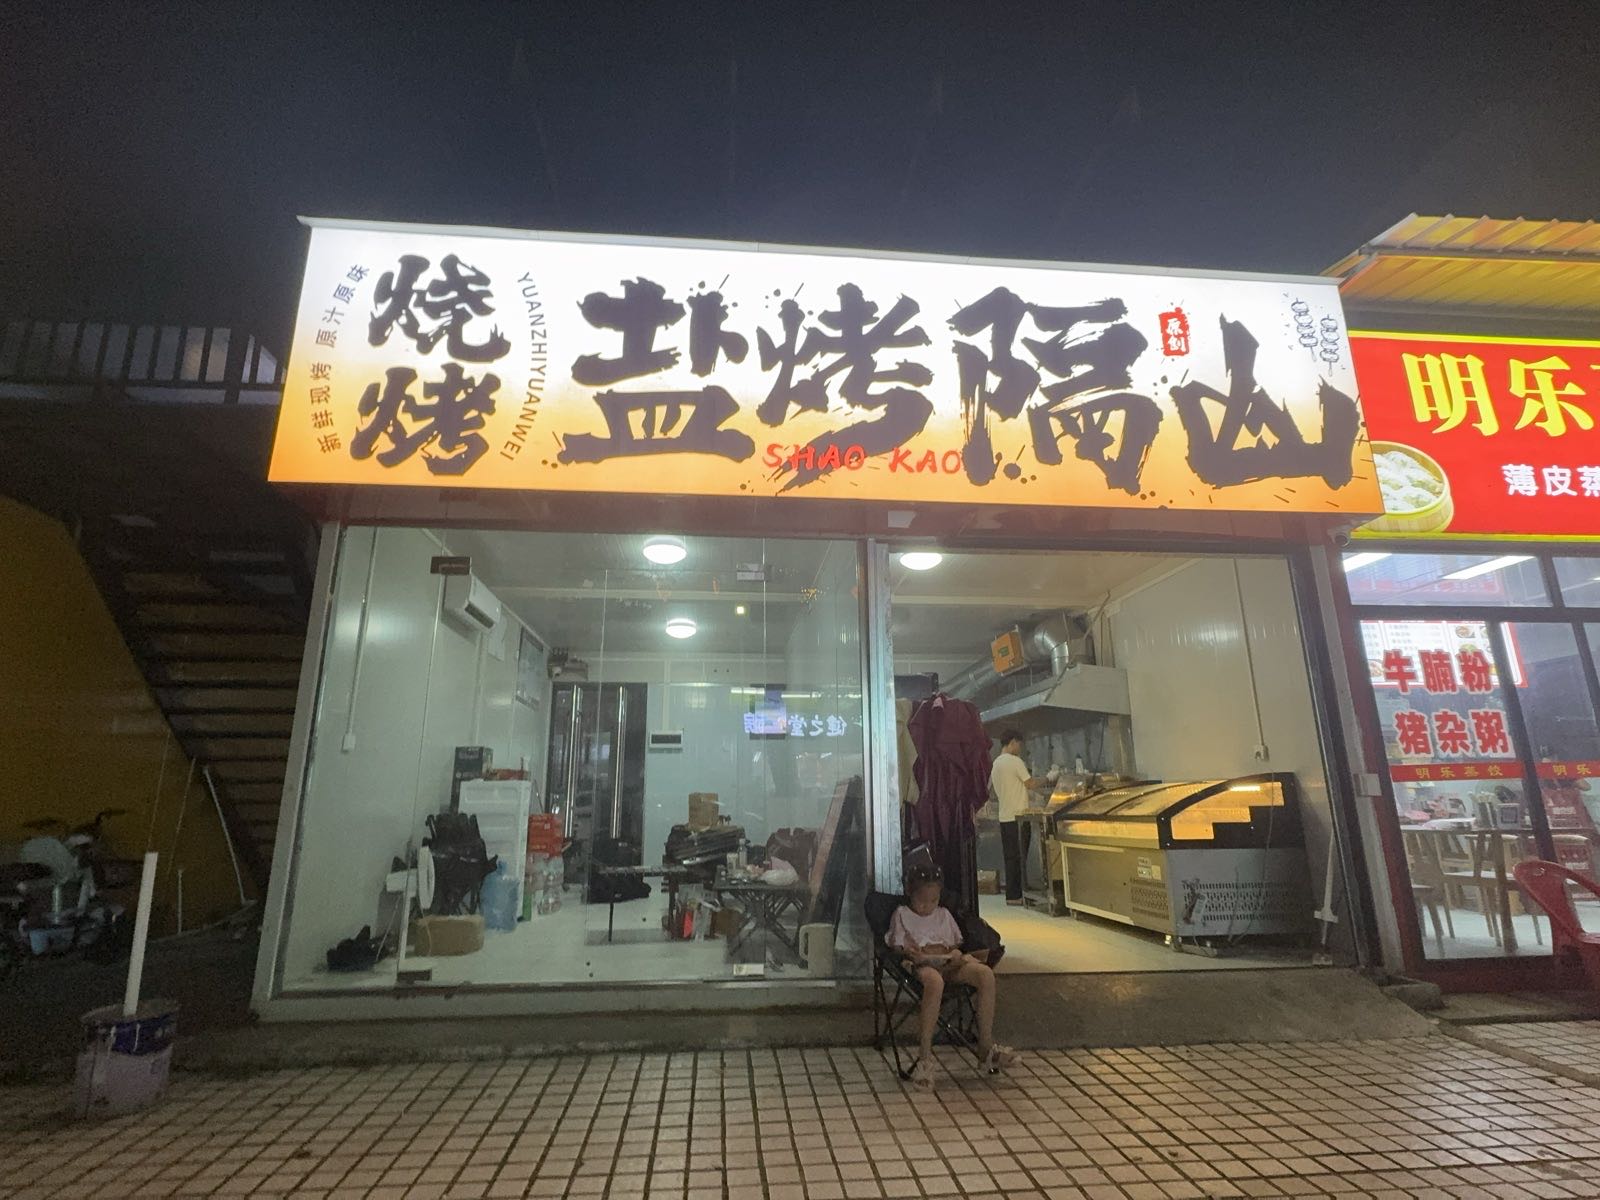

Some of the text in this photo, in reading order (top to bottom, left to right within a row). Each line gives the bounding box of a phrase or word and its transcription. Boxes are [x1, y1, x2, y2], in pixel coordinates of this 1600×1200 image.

[309, 264, 370, 454] 新鲜现烤 原汁原味
[350, 253, 511, 476] 烧烤
[499, 271, 548, 462] YUANZHIYUANWEI
[1402, 352, 1600, 437] 明乐
[762, 443, 962, 475] SHAO KAO
[1382, 648, 1494, 694] 牛腩粉
[1394, 709, 1513, 756] 猪杂粥
[1415, 764, 1503, 779] 明乐蒸饺
